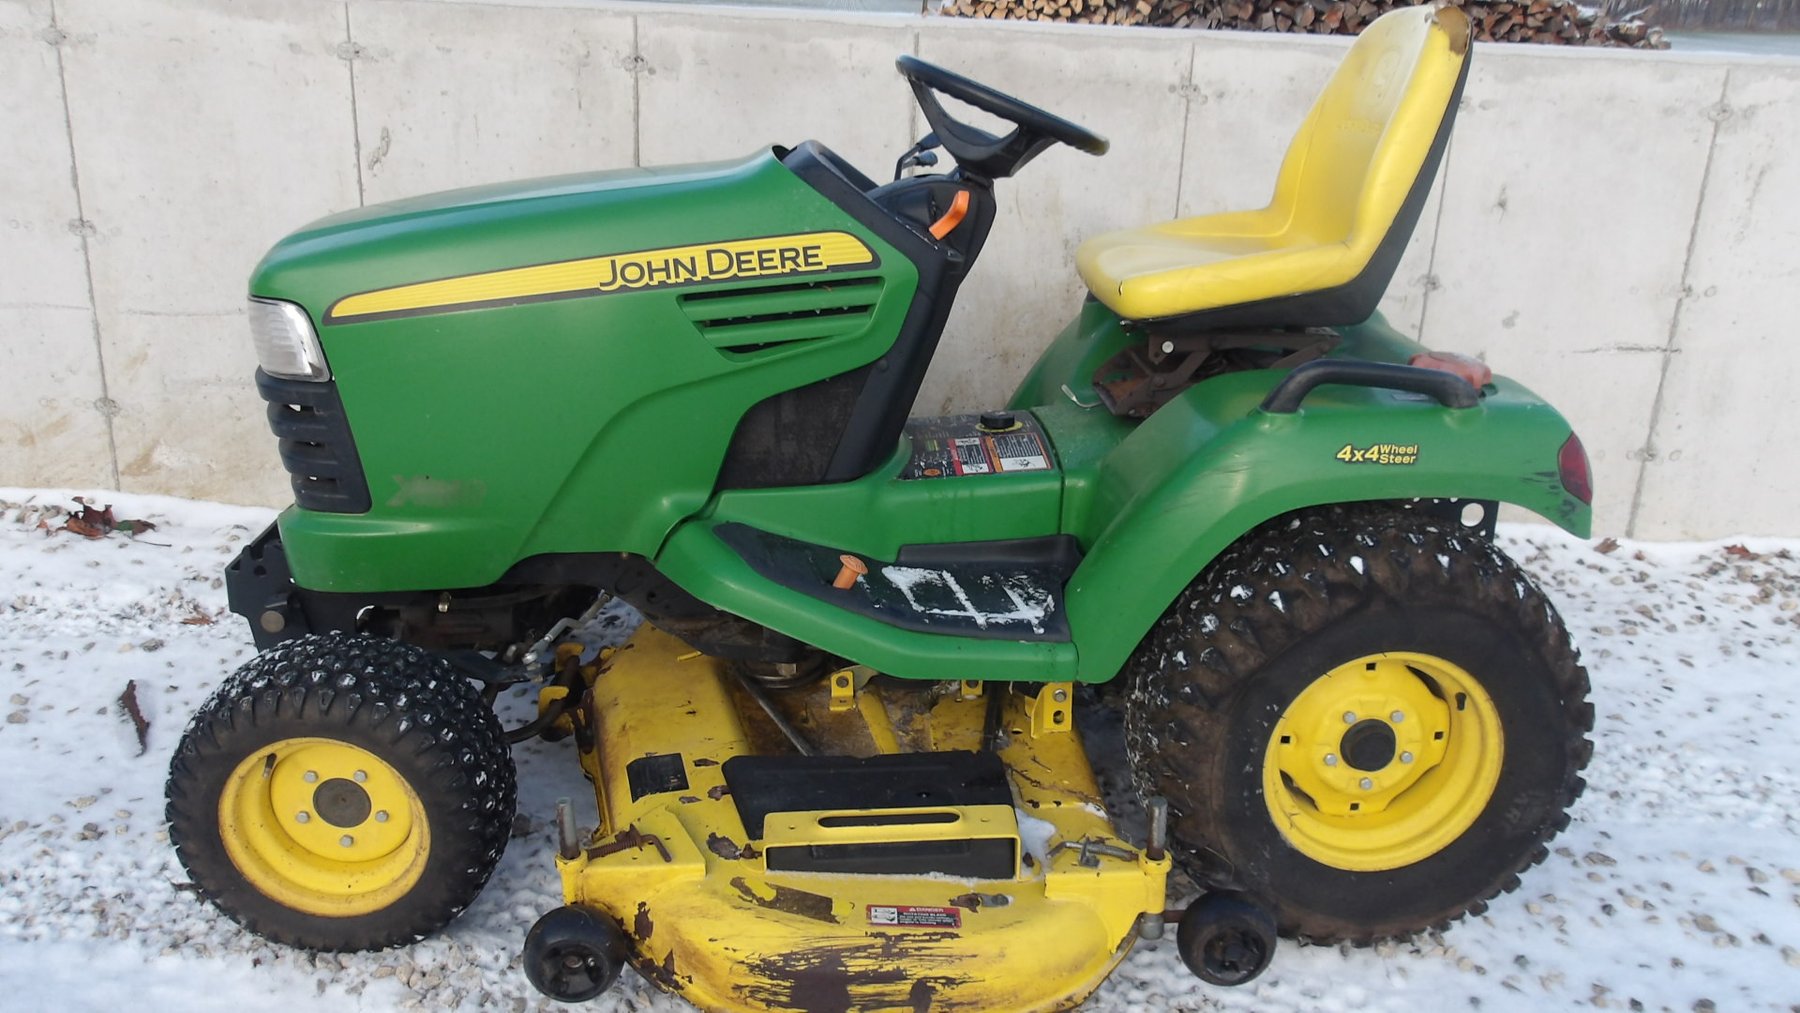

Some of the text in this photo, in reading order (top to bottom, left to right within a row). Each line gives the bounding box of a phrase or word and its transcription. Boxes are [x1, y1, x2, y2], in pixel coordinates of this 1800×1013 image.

[599, 245, 824, 288] JOHN DEERE
[1336, 444, 1418, 463] 4x4 Wheel
[1379, 454, 1417, 464] Steer
